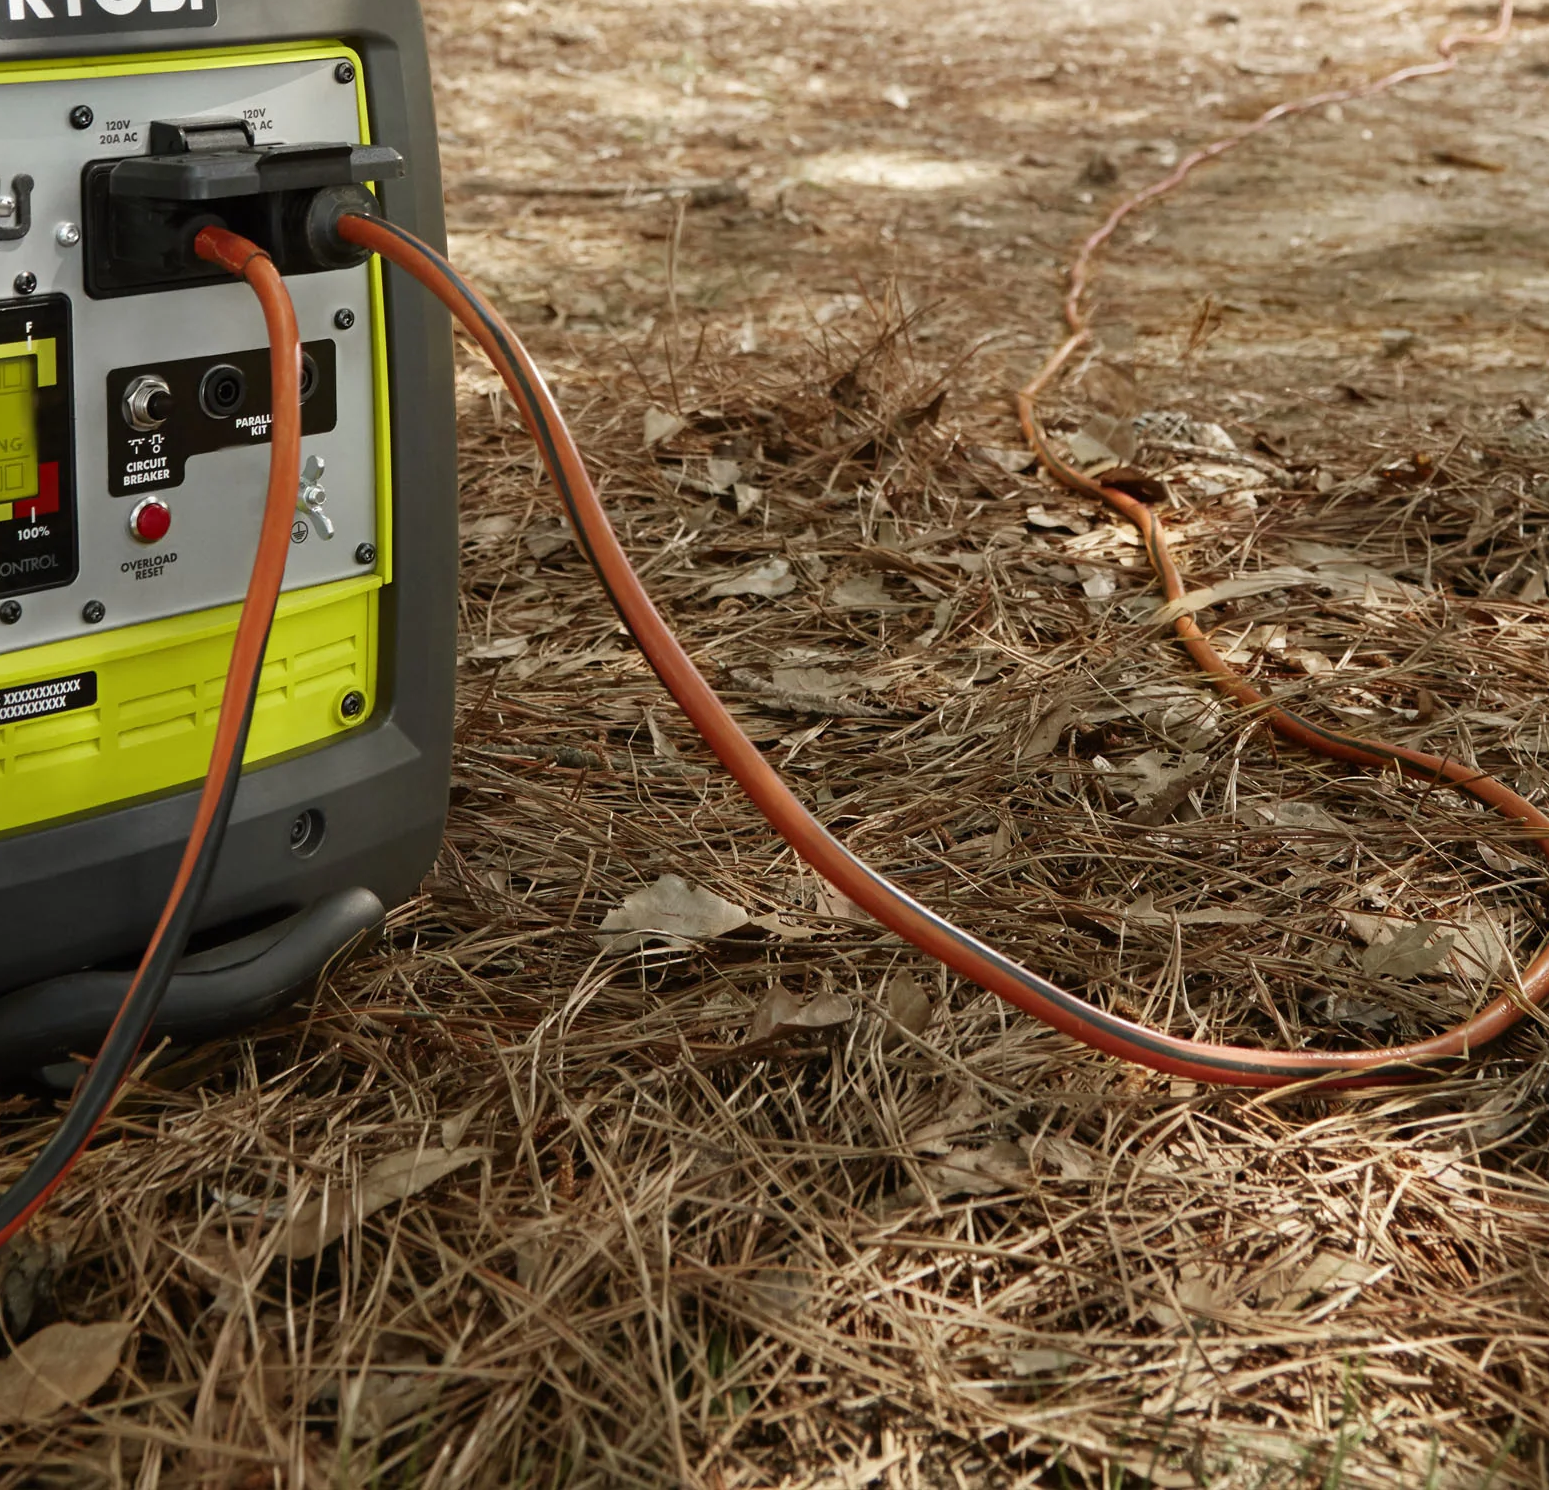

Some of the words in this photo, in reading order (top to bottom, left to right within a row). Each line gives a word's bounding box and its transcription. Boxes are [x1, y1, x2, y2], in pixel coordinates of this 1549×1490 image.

[243, 108, 266, 119] 120V
[106, 120, 130, 131] 120V
[259, 120, 273, 130] AC
[100, 134, 120, 145] 20A
[123, 132, 138, 142] AC
[25, 322, 33, 333] F
[235, 414, 273, 430] PARALL
[251, 425, 268, 437] KIT
[126, 457, 167, 473] CIRCUIT
[123, 469, 170, 487] BREAKER
[18, 526, 50, 541] 100%
[121, 553, 177, 574] OVERLOAD
[135, 566, 164, 581] RESET
